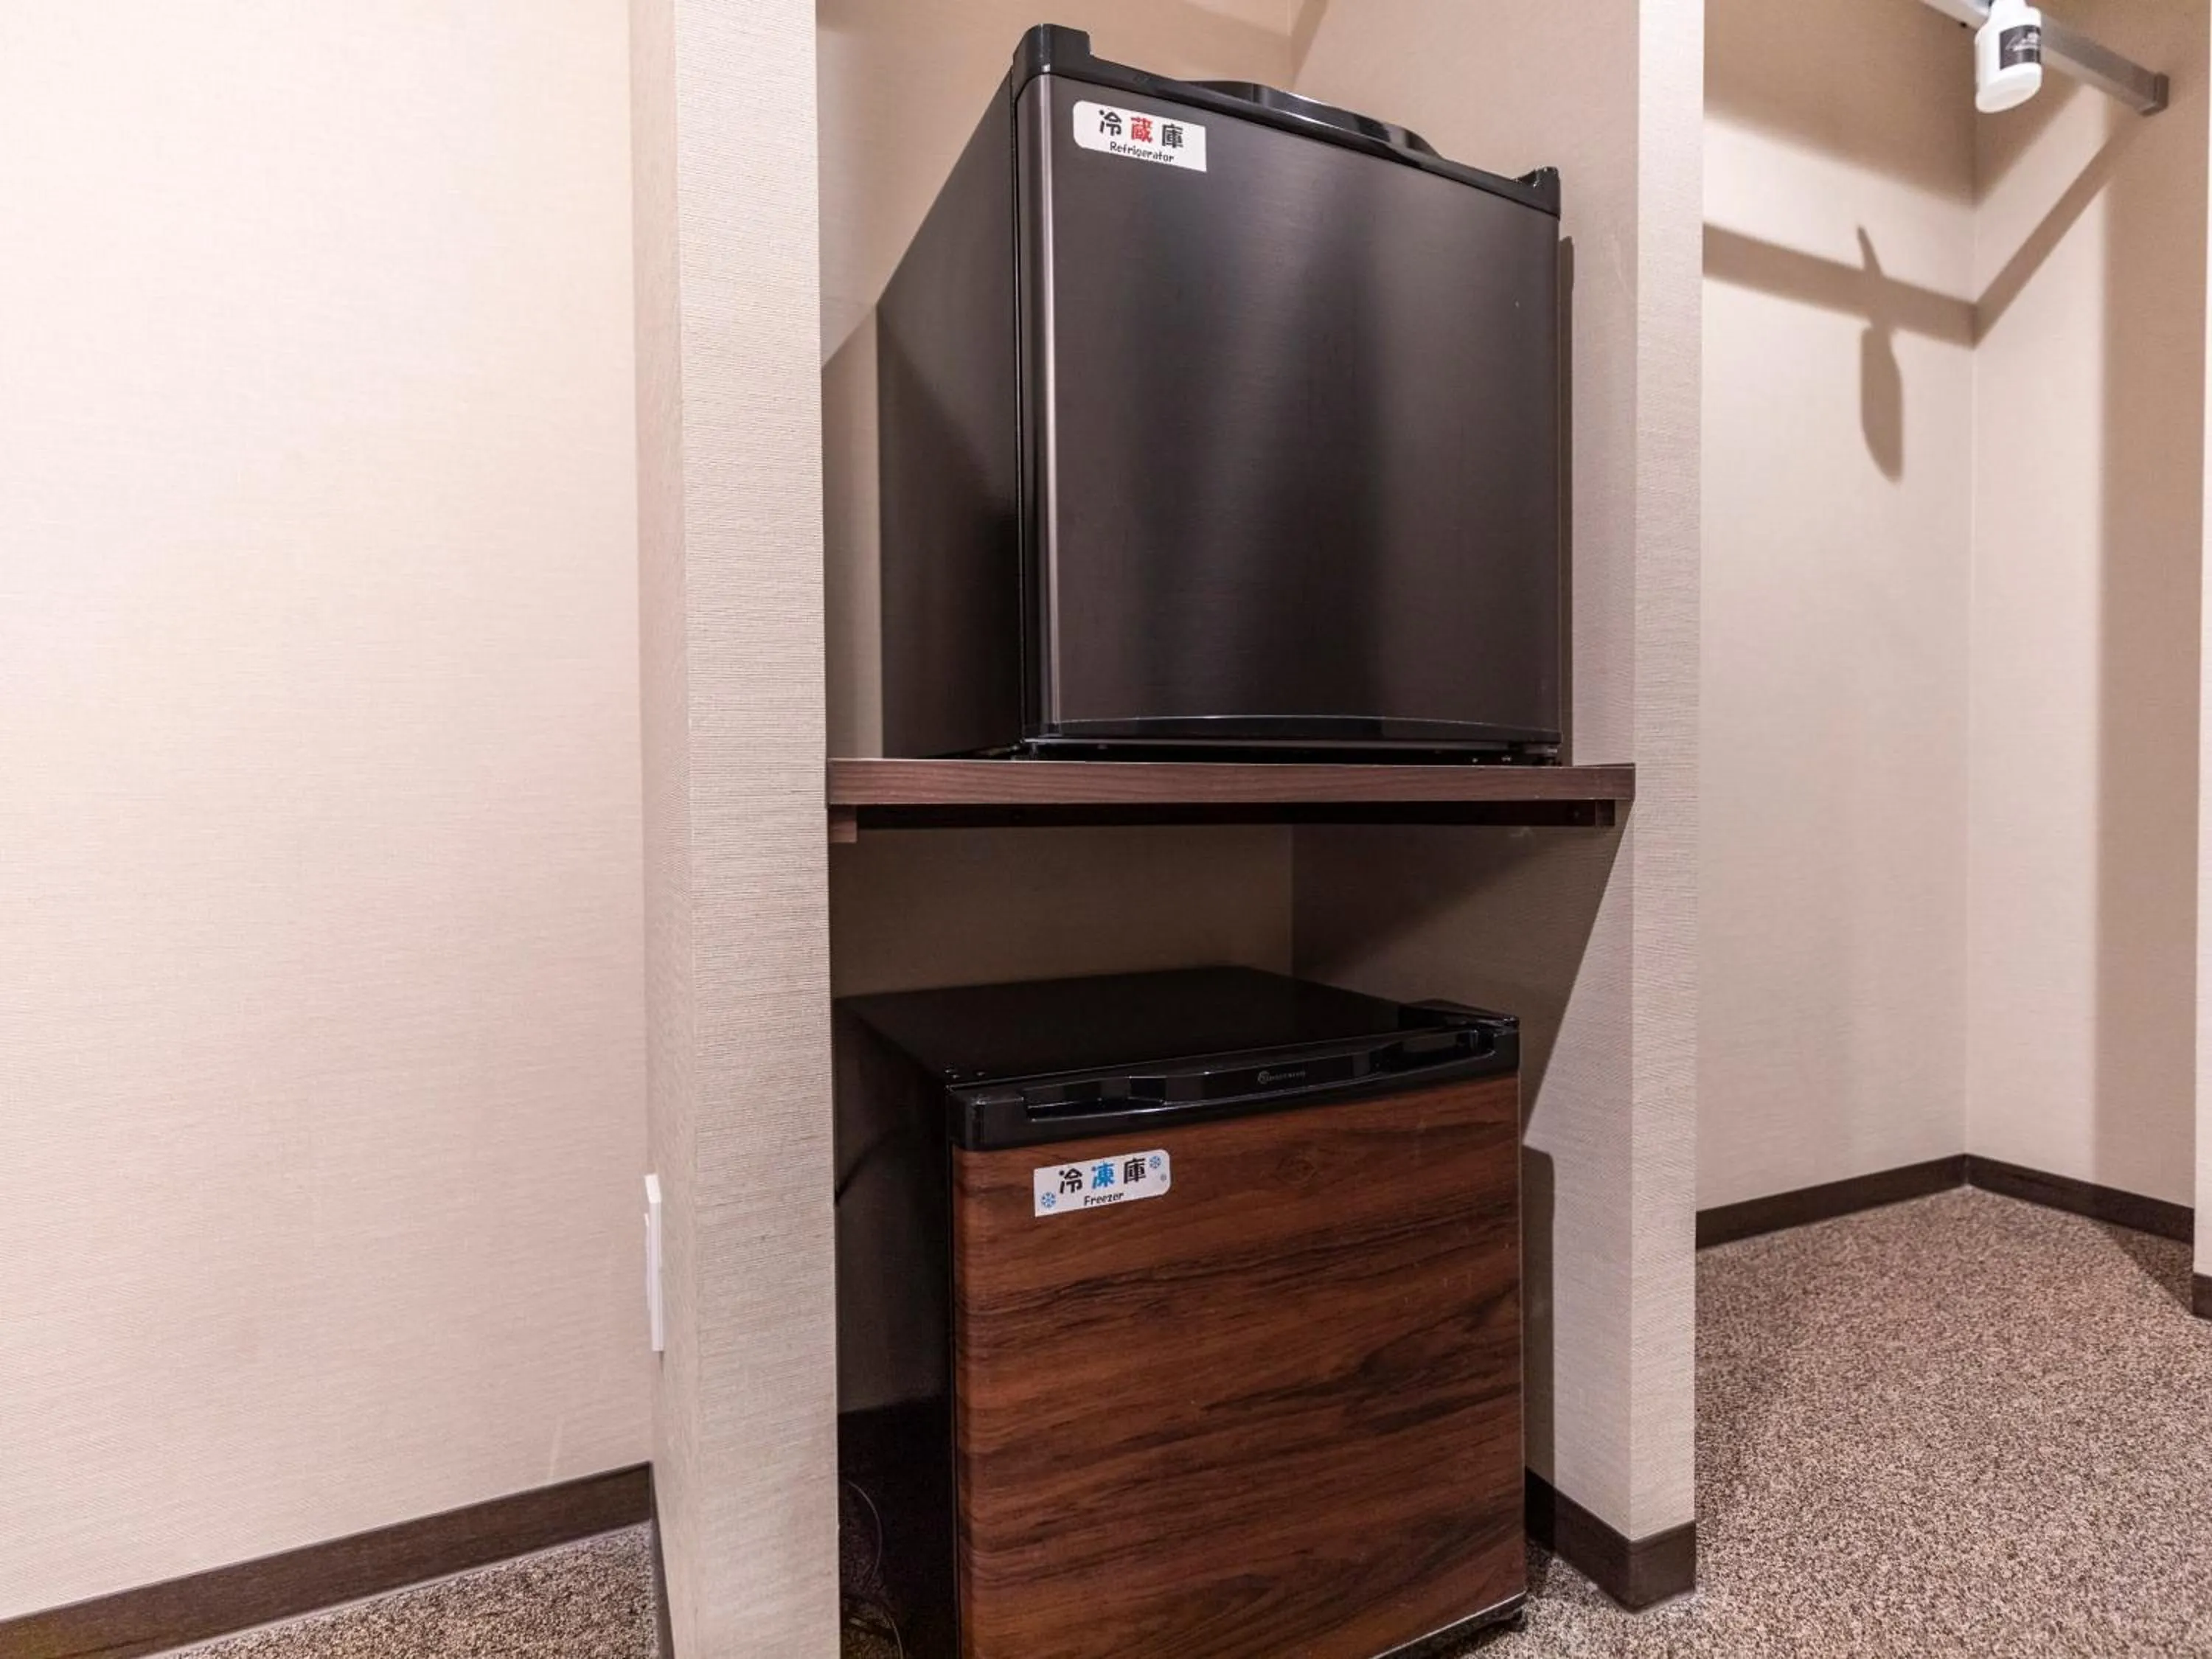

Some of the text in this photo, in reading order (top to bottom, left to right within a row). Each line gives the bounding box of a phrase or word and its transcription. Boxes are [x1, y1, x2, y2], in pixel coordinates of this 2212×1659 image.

[1099, 110, 1183, 148] 冷蔵庫
[1110, 142, 1175, 162] Refrigerator
[1059, 1158, 1147, 1194] 冷凍庫
[1084, 1192, 1124, 1206] Freezer
